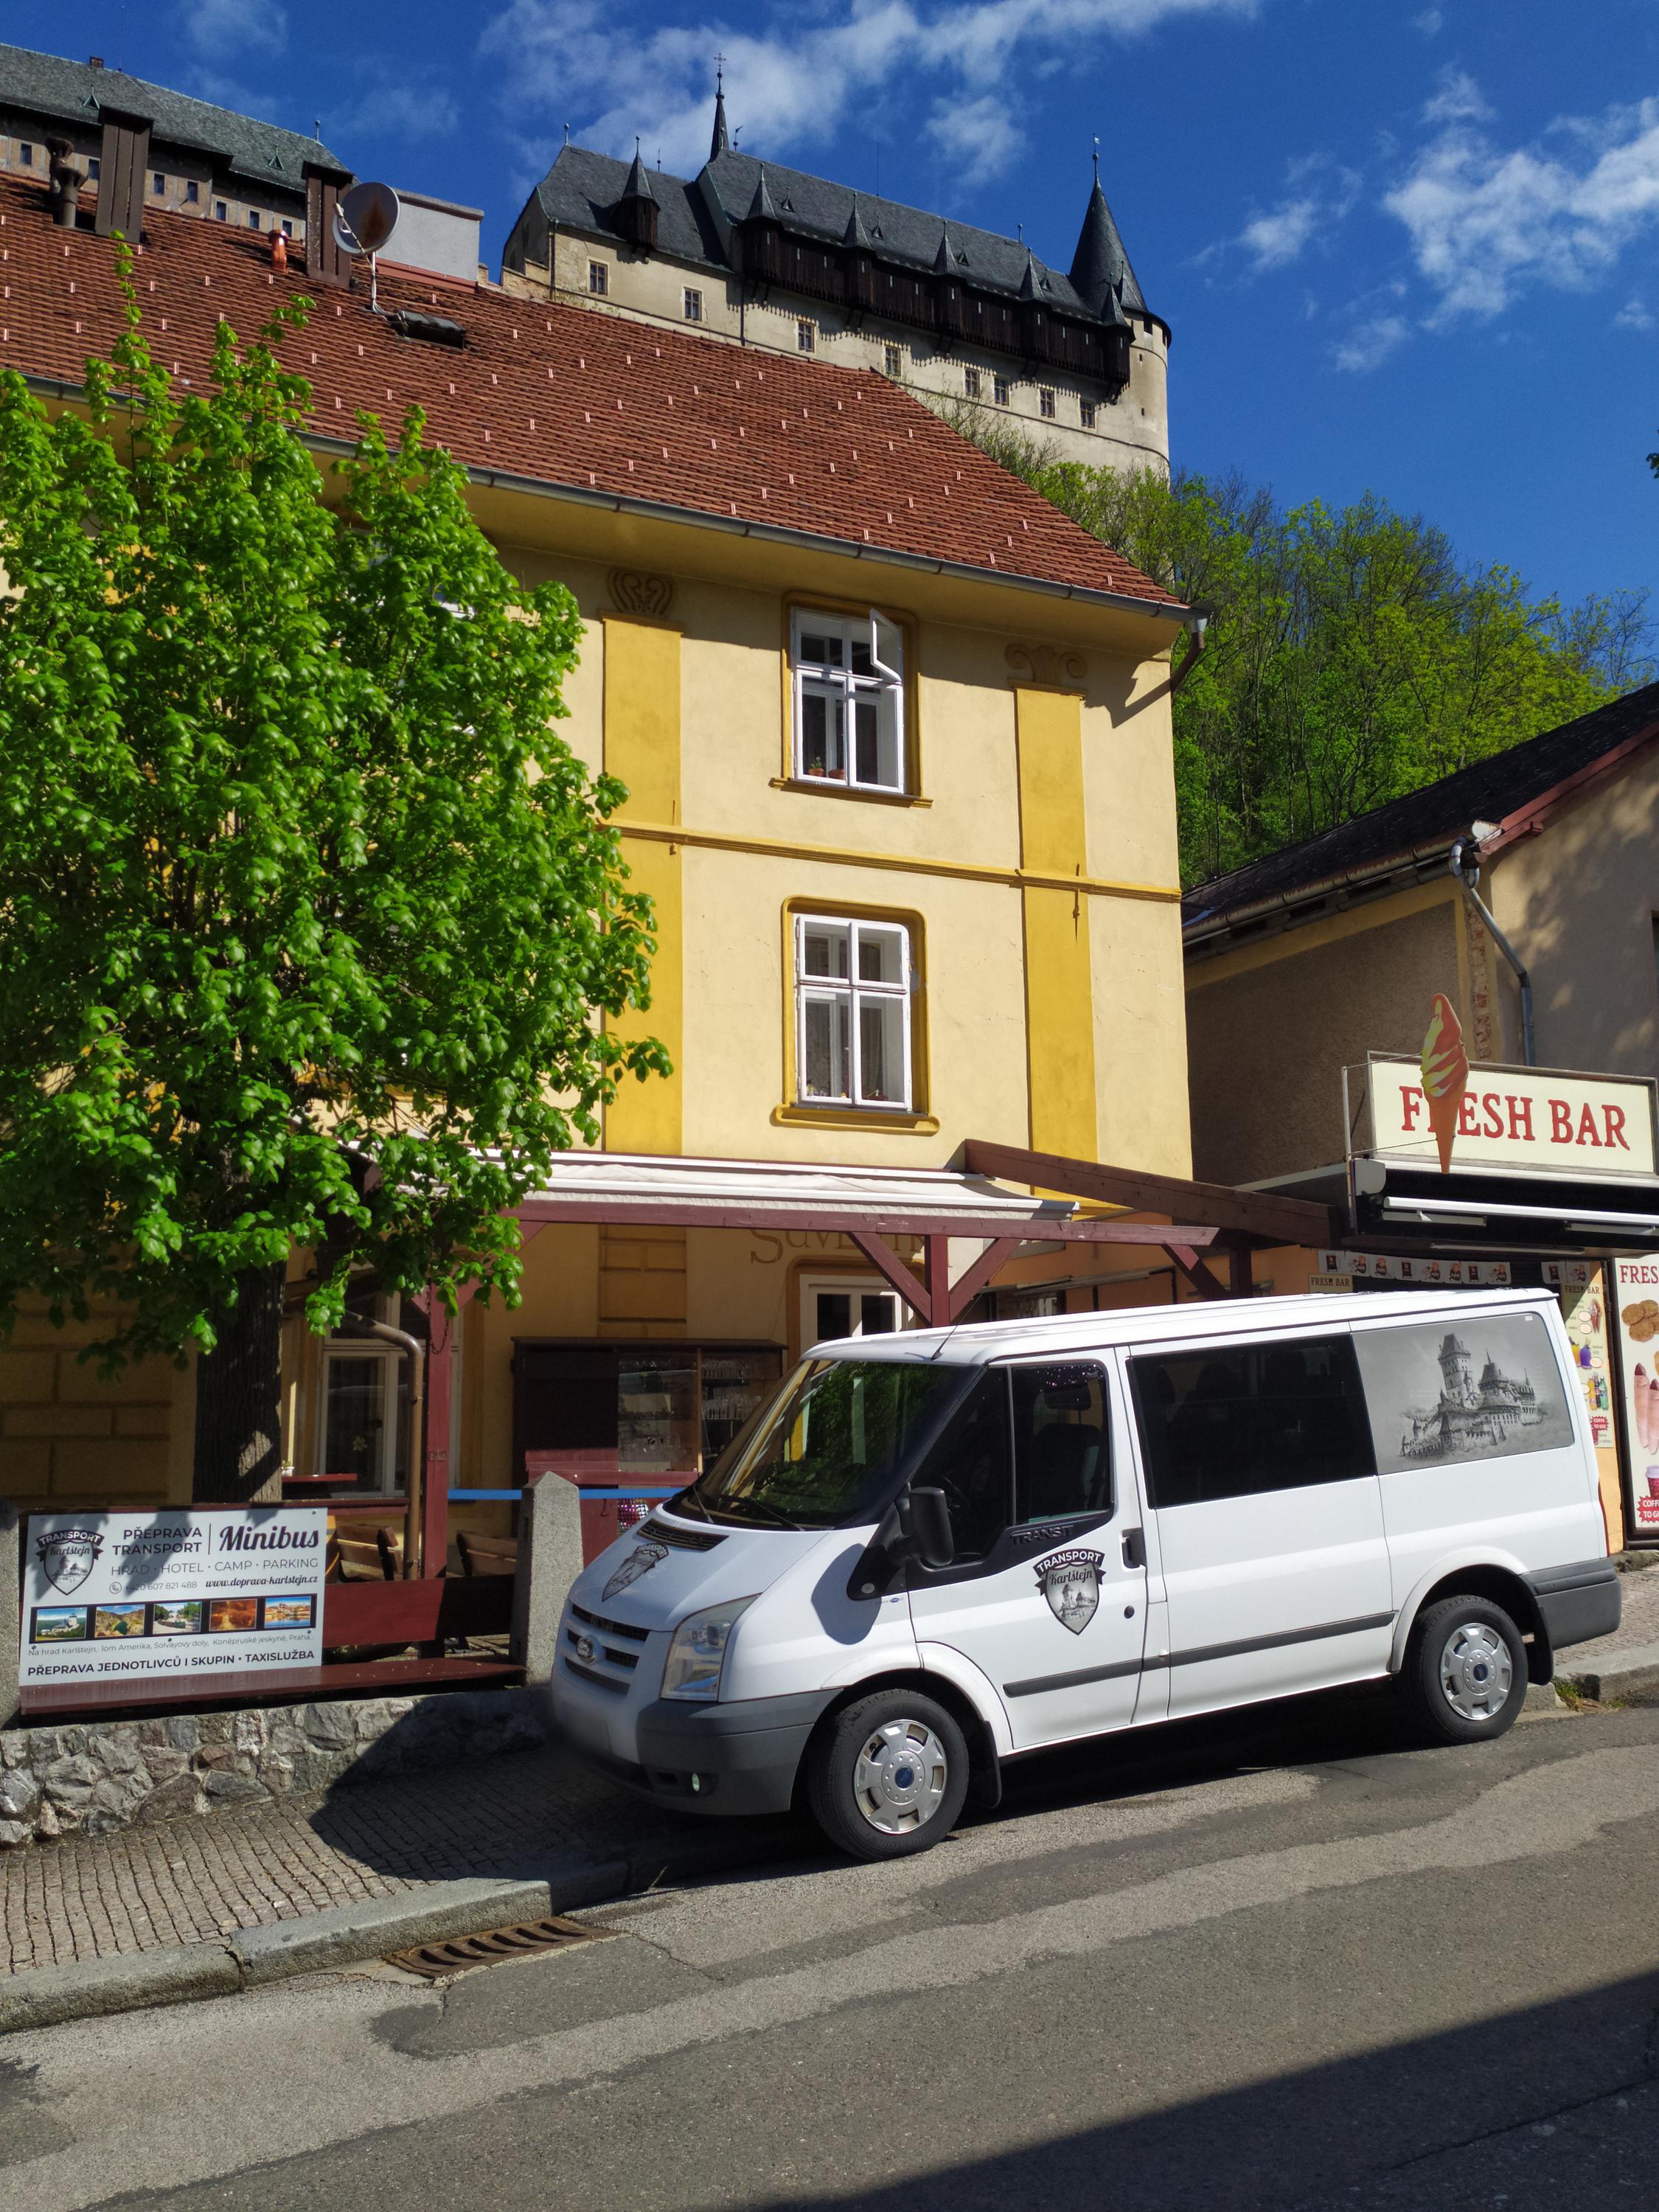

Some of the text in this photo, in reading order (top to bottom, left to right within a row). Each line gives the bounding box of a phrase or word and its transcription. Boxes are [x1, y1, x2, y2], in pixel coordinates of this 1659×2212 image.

[1399, 1085, 1631, 1151] FESH BAR
[1310, 1277, 1350, 1287] FRESH BAR
[1587, 1286, 1600, 1294] BAR
[38, 1531, 101, 1545] TRANSPORT
[123, 1526, 202, 1540] PŘEPRAVA
[219, 1526, 319, 1551] Minibus
[1012, 1525, 1074, 1545] TRANSIT
[49, 1545, 90, 1557] Karlštejn
[112, 1542, 202, 1555] TRANSPORT
[111, 1558, 319, 1576] HRAD HOTEL CAMP PARKING
[1037, 1551, 1102, 1573] TRANSPORT
[206, 1574, 319, 1588] www.doprava-karlstejn.cz
[1049, 1568, 1093, 1586] Karlštejn
[147, 1582, 164, 1590] 607
[165, 1582, 178, 1590] 821
[181, 1581, 198, 1589] 488
[118, 1643, 152, 1652] Amerika,
[28, 1649, 315, 1676] PŘEPRAVA JEDNOTLIVCŮ I SKUPIN TAXISLUŽBA
